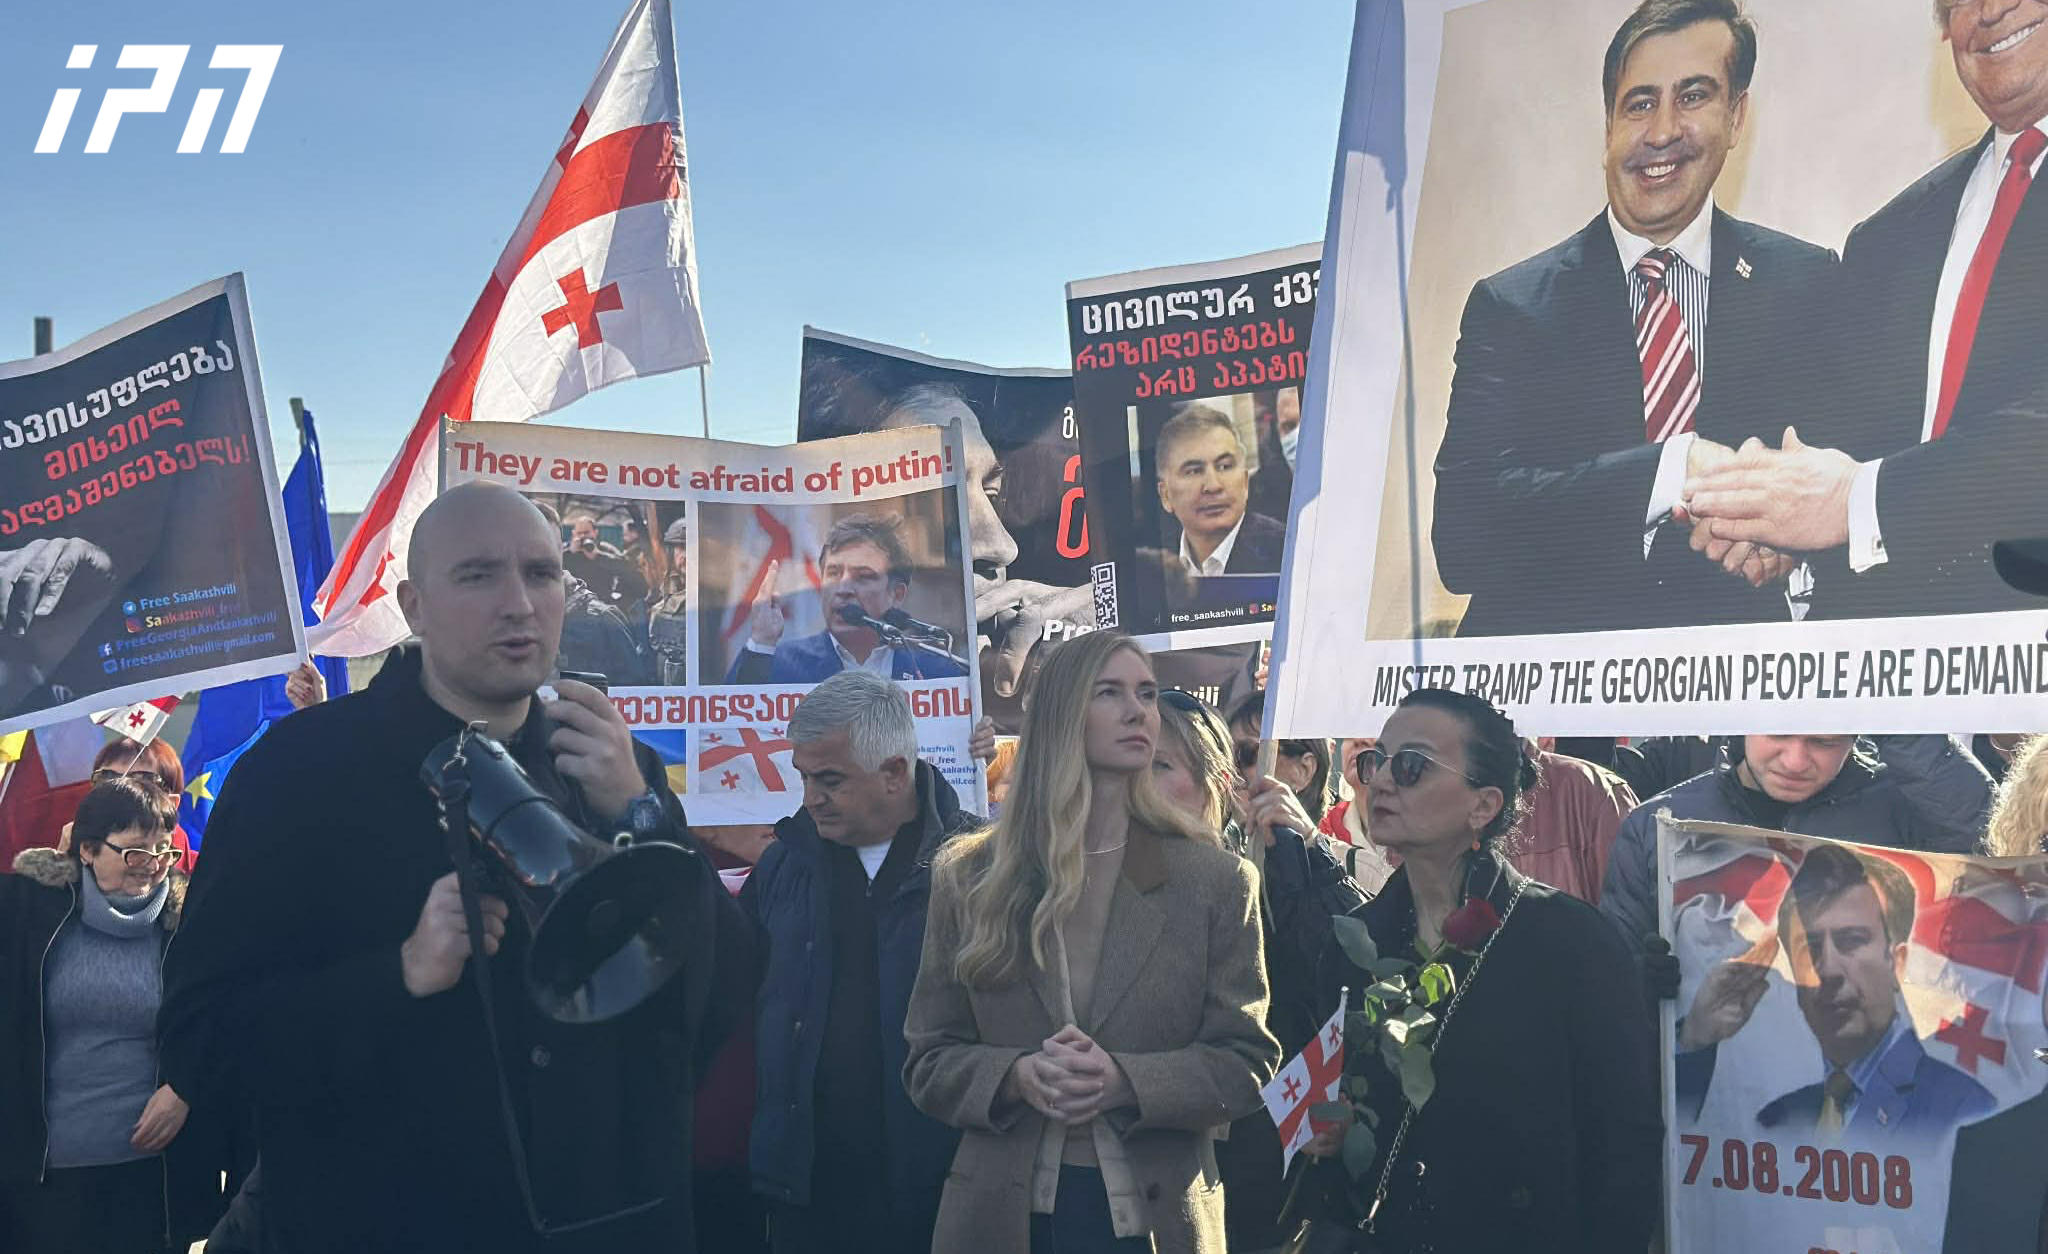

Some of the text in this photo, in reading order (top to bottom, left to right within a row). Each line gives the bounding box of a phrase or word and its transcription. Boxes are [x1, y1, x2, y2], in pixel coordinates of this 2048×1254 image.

[1082, 283, 1255, 334] ცივილურ
[1076, 318, 1295, 371] რეზიდენტებს
[0, 340, 234, 450] ავისუფლება
[1136, 351, 1309, 398] არც აპატი
[44, 398, 184, 480] მიხეილ
[1, 434, 250, 535] აღმაშენებელს!
[454, 442, 953, 496] They are not afraid of putin!
[140, 592, 171, 611] Free
[1463, 662, 1543, 705] TRAMP
[1550, 660, 1595, 704] THE
[1601, 654, 1733, 704] GEORGIAN
[1742, 651, 1850, 700] PEOPLE
[1856, 649, 1915, 698] ARE
[1680, 1134, 1913, 1209] 7.08.2008
